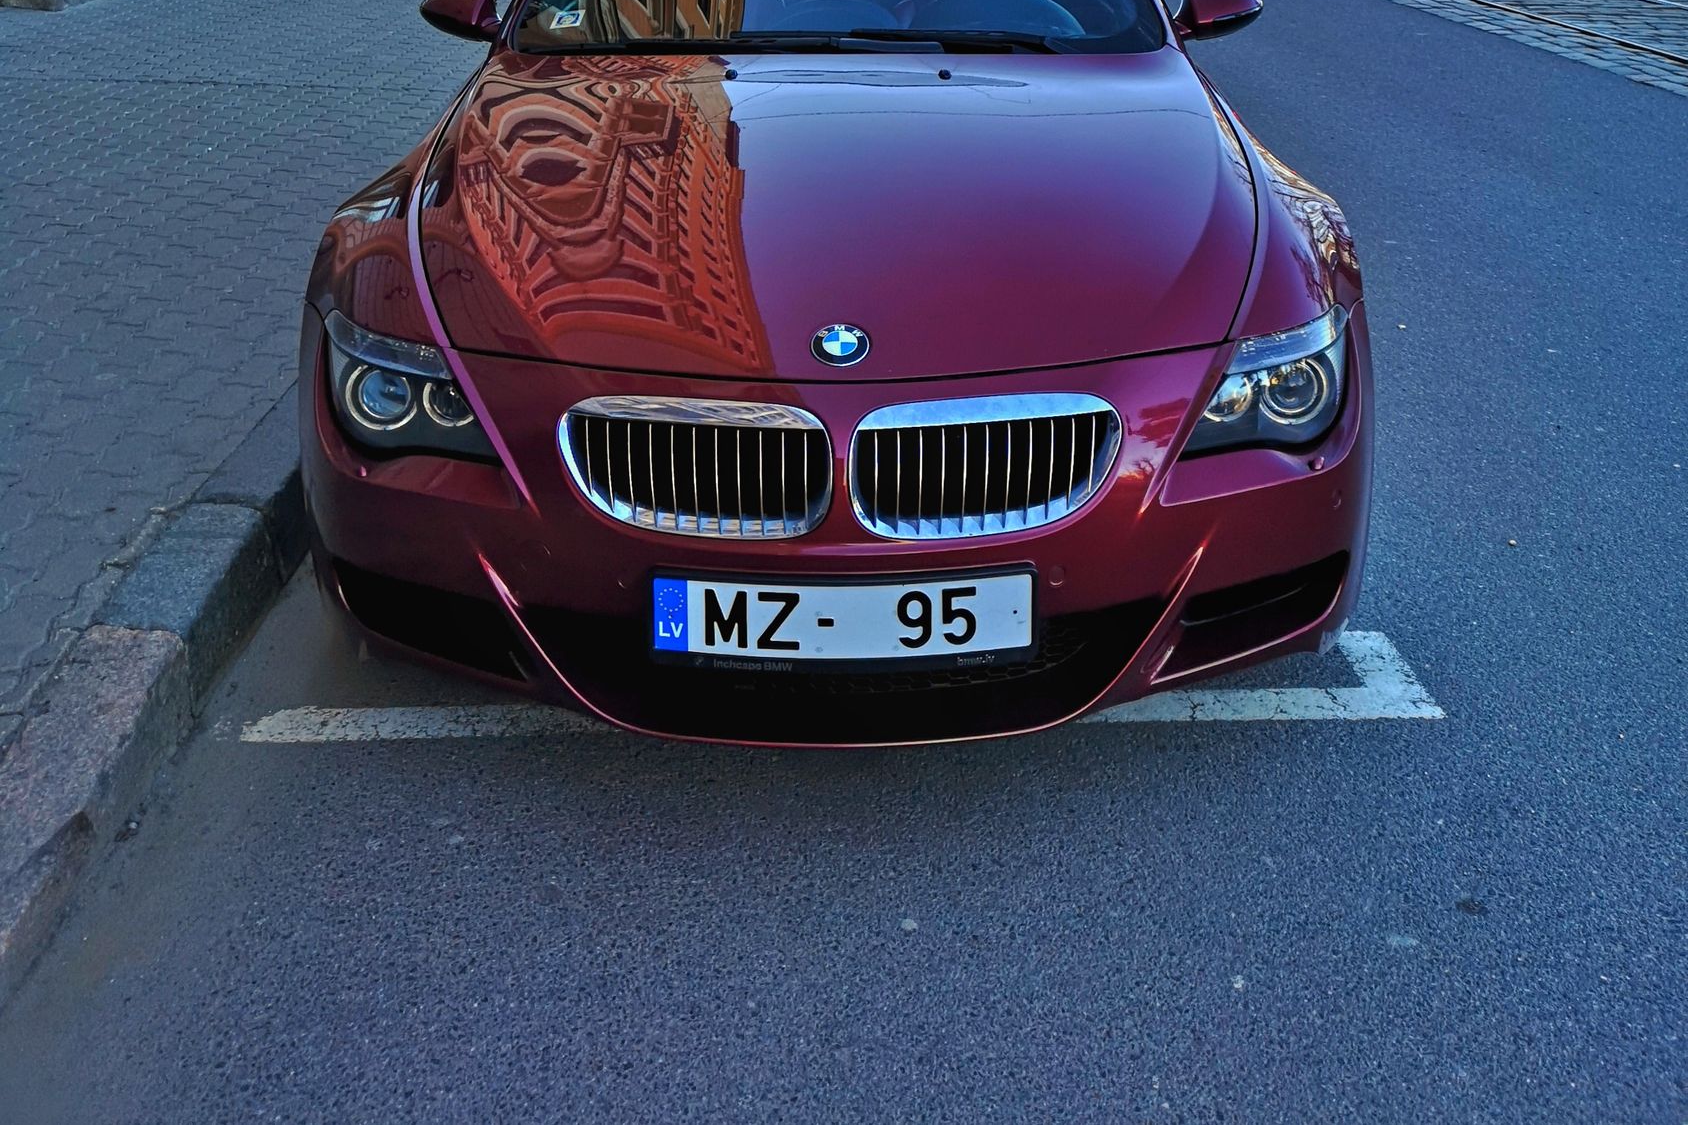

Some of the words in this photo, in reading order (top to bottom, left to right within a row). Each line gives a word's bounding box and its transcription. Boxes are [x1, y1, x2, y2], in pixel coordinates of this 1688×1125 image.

[818, 325, 864, 337] BMW
[896, 586, 977, 649] 95
[658, 621, 684, 639] LV
[763, 660, 793, 672] BMW
[956, 653, 996, 667] bmw.lv
